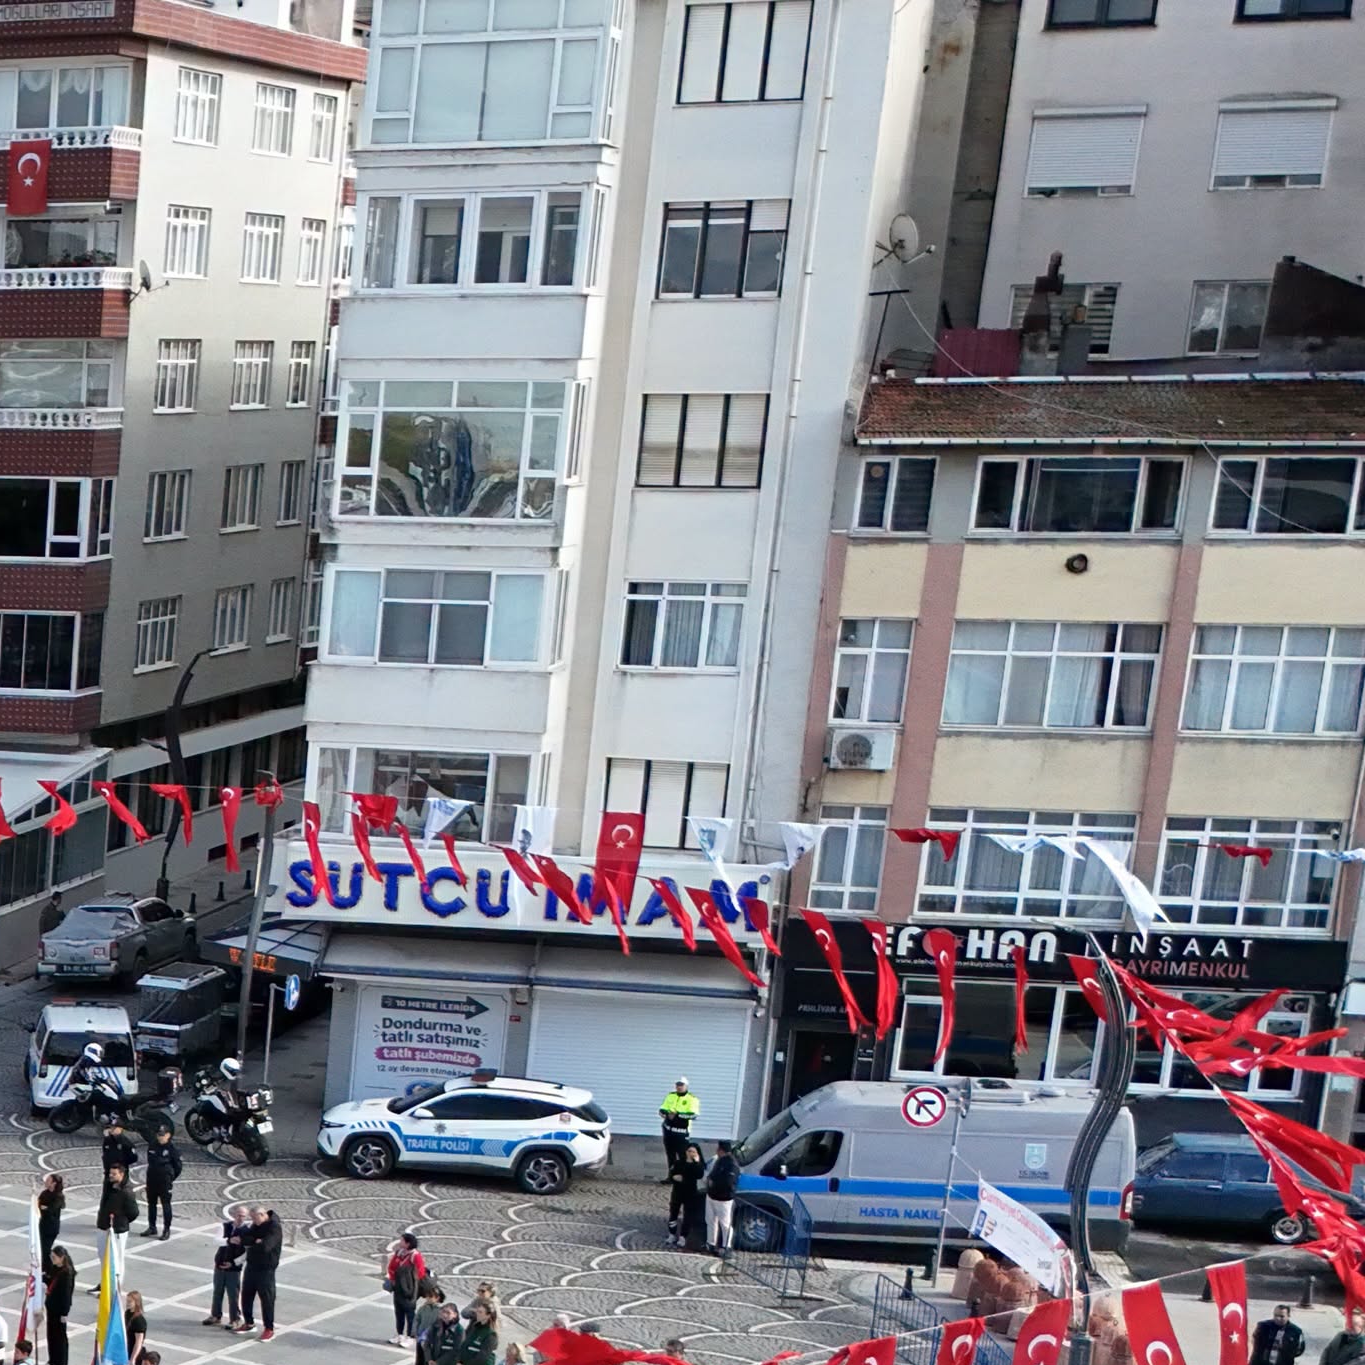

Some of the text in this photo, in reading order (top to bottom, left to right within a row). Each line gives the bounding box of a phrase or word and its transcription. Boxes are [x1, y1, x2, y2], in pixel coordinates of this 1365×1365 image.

[287, 859, 510, 918] SÜTCÜ
[1111, 935, 1253, 958] İNŞAAT
[409, 1001, 438, 1010] METRE
[382, 1017, 482, 1036] Dondurma ve
[381, 1031, 480, 1049] tatlı satışımız
[382, 1047, 476, 1065] tatlı şubemizde
[400, 1064, 428, 1073] devam
[407, 1138, 469, 1152] TRAFİK POLİSİ
[859, 1206, 900, 1219] HASTA
